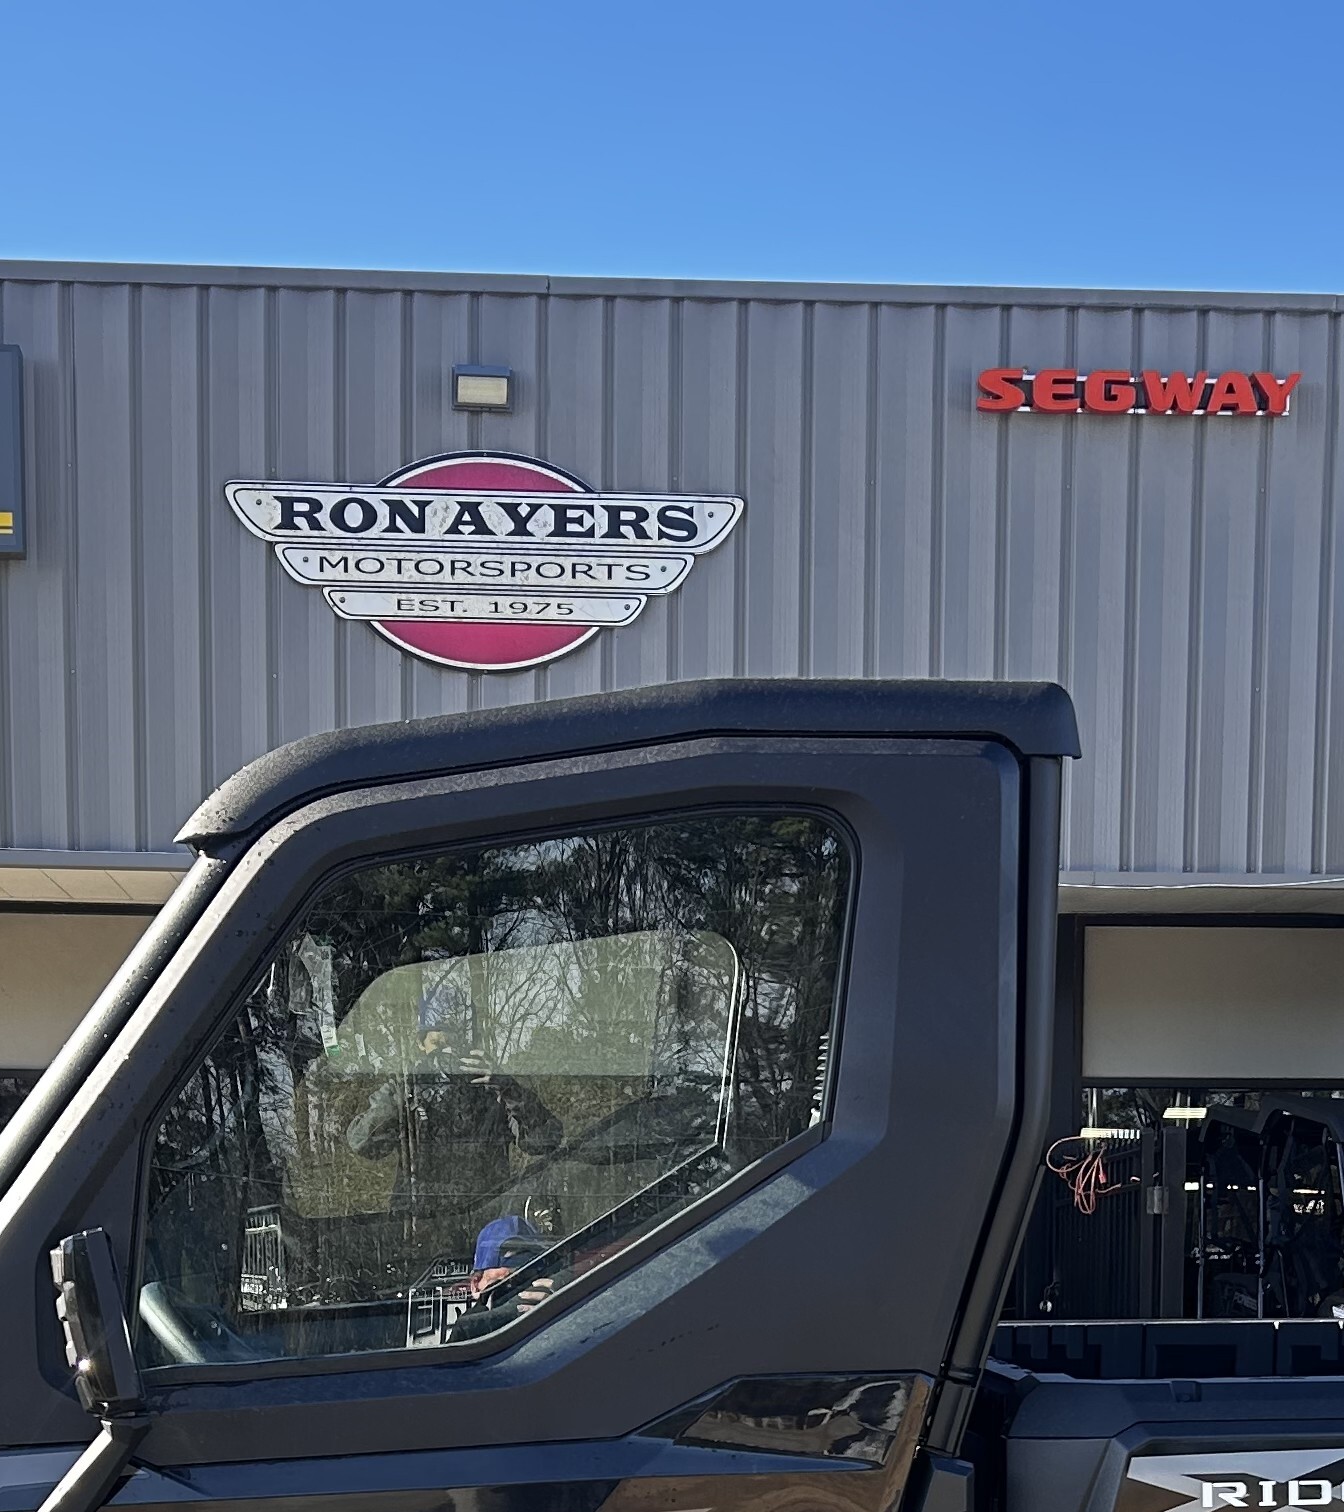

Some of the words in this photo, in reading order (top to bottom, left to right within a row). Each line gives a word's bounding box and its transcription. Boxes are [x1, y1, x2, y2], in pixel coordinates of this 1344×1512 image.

[976, 368, 1304, 415] SEGWAY
[273, 494, 433, 535] RON
[439, 502, 698, 542] AYERS
[317, 554, 651, 582] MOTORSPORTS
[395, 598, 467, 614] EST.
[488, 600, 575, 617] 1975
